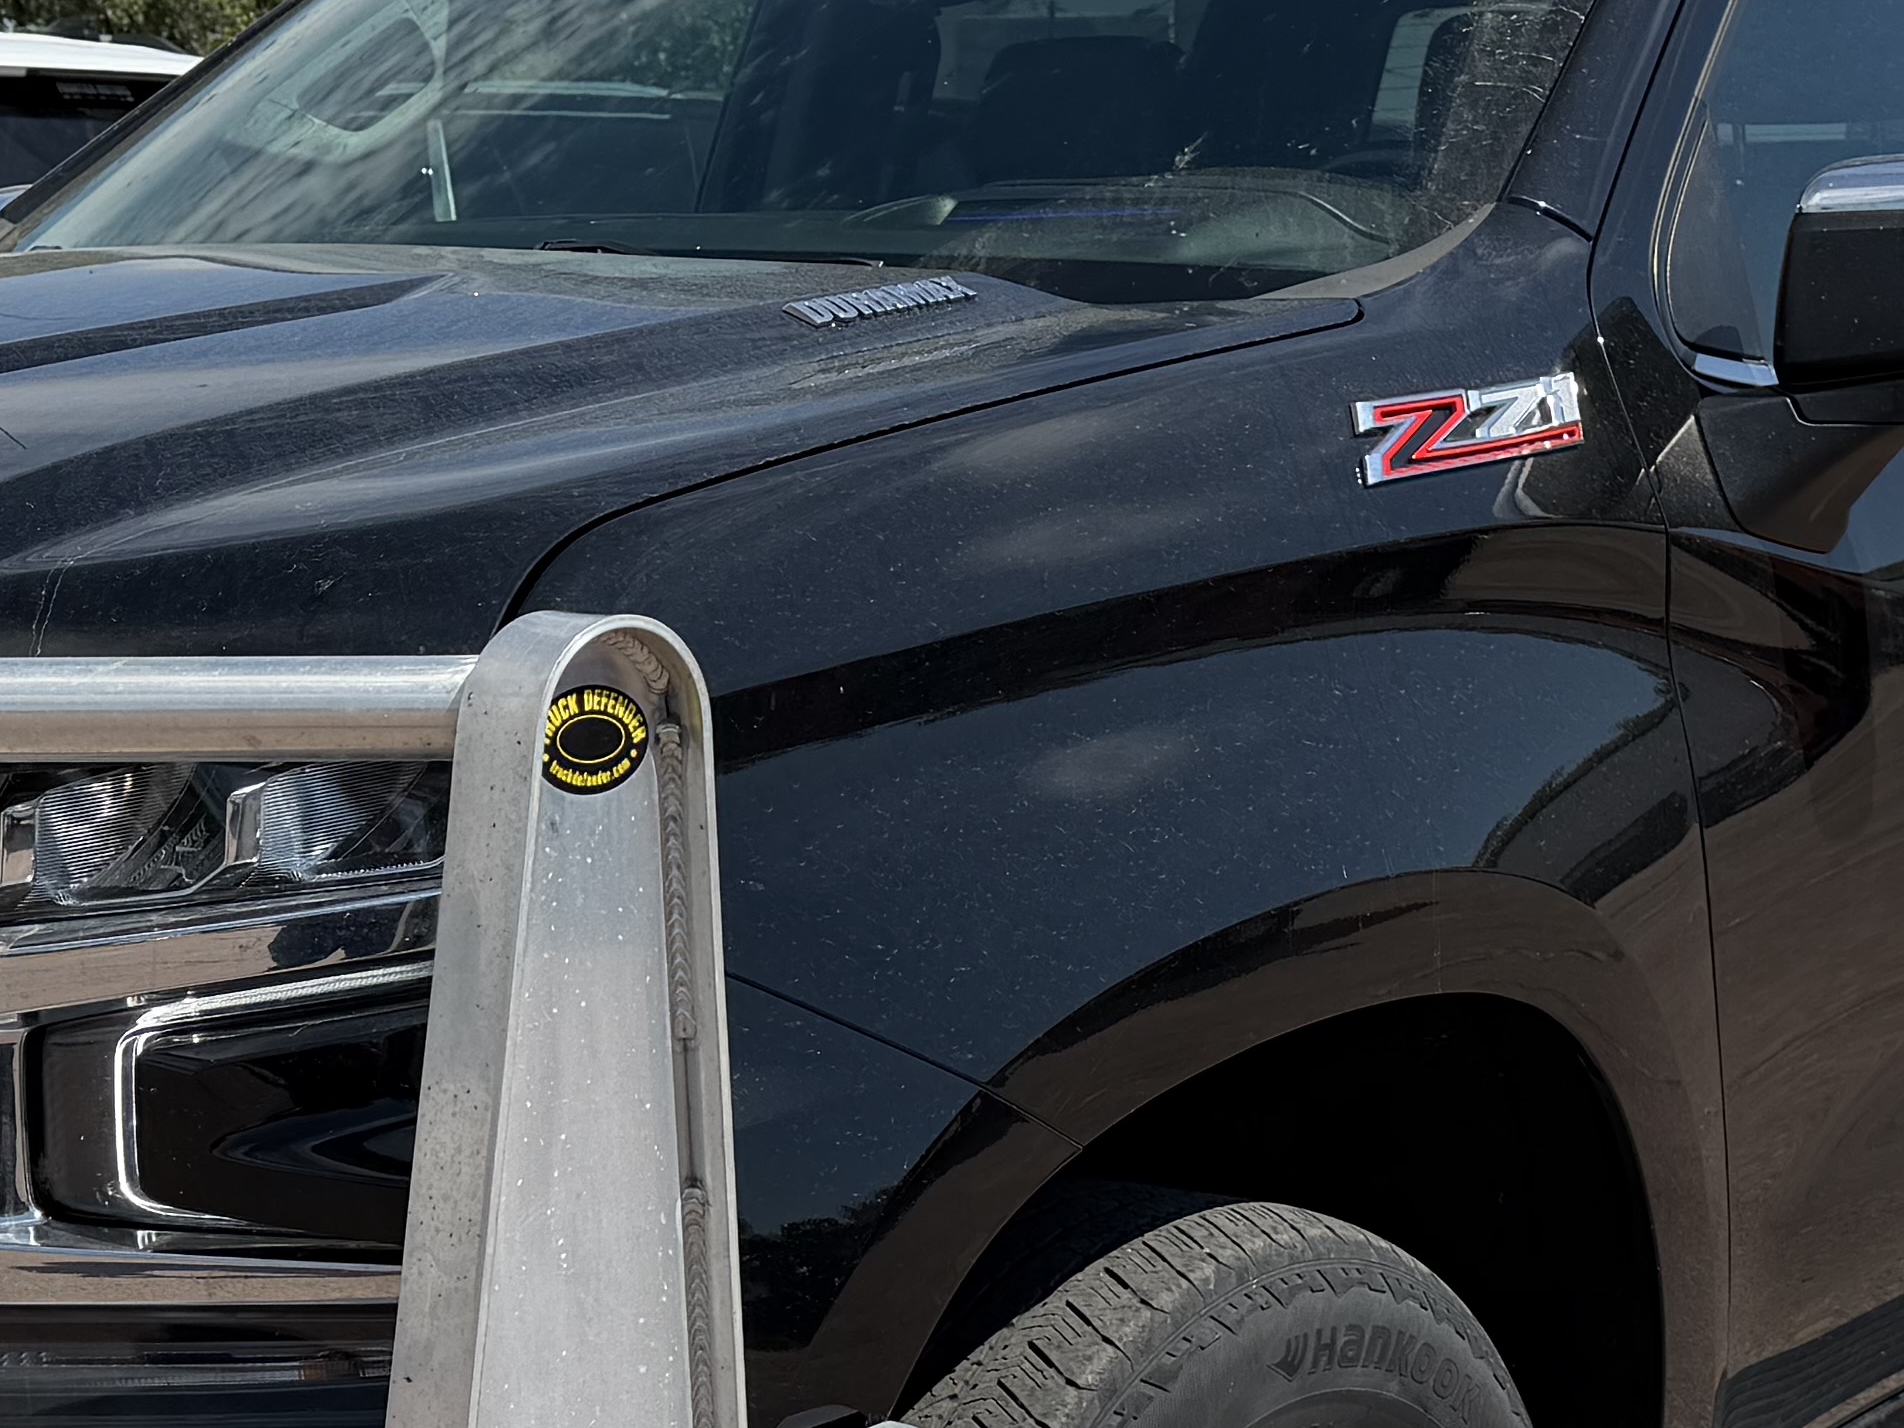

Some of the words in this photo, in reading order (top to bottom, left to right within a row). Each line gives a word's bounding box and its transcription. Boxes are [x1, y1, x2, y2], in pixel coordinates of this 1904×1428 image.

[782, 275, 978, 329] DURAMAX
[1349, 371, 1585, 489] Z71
[543, 692, 580, 745] RUCK
[583, 689, 648, 745] DEFENDER
[549, 757, 632, 788] truckdefender.com
